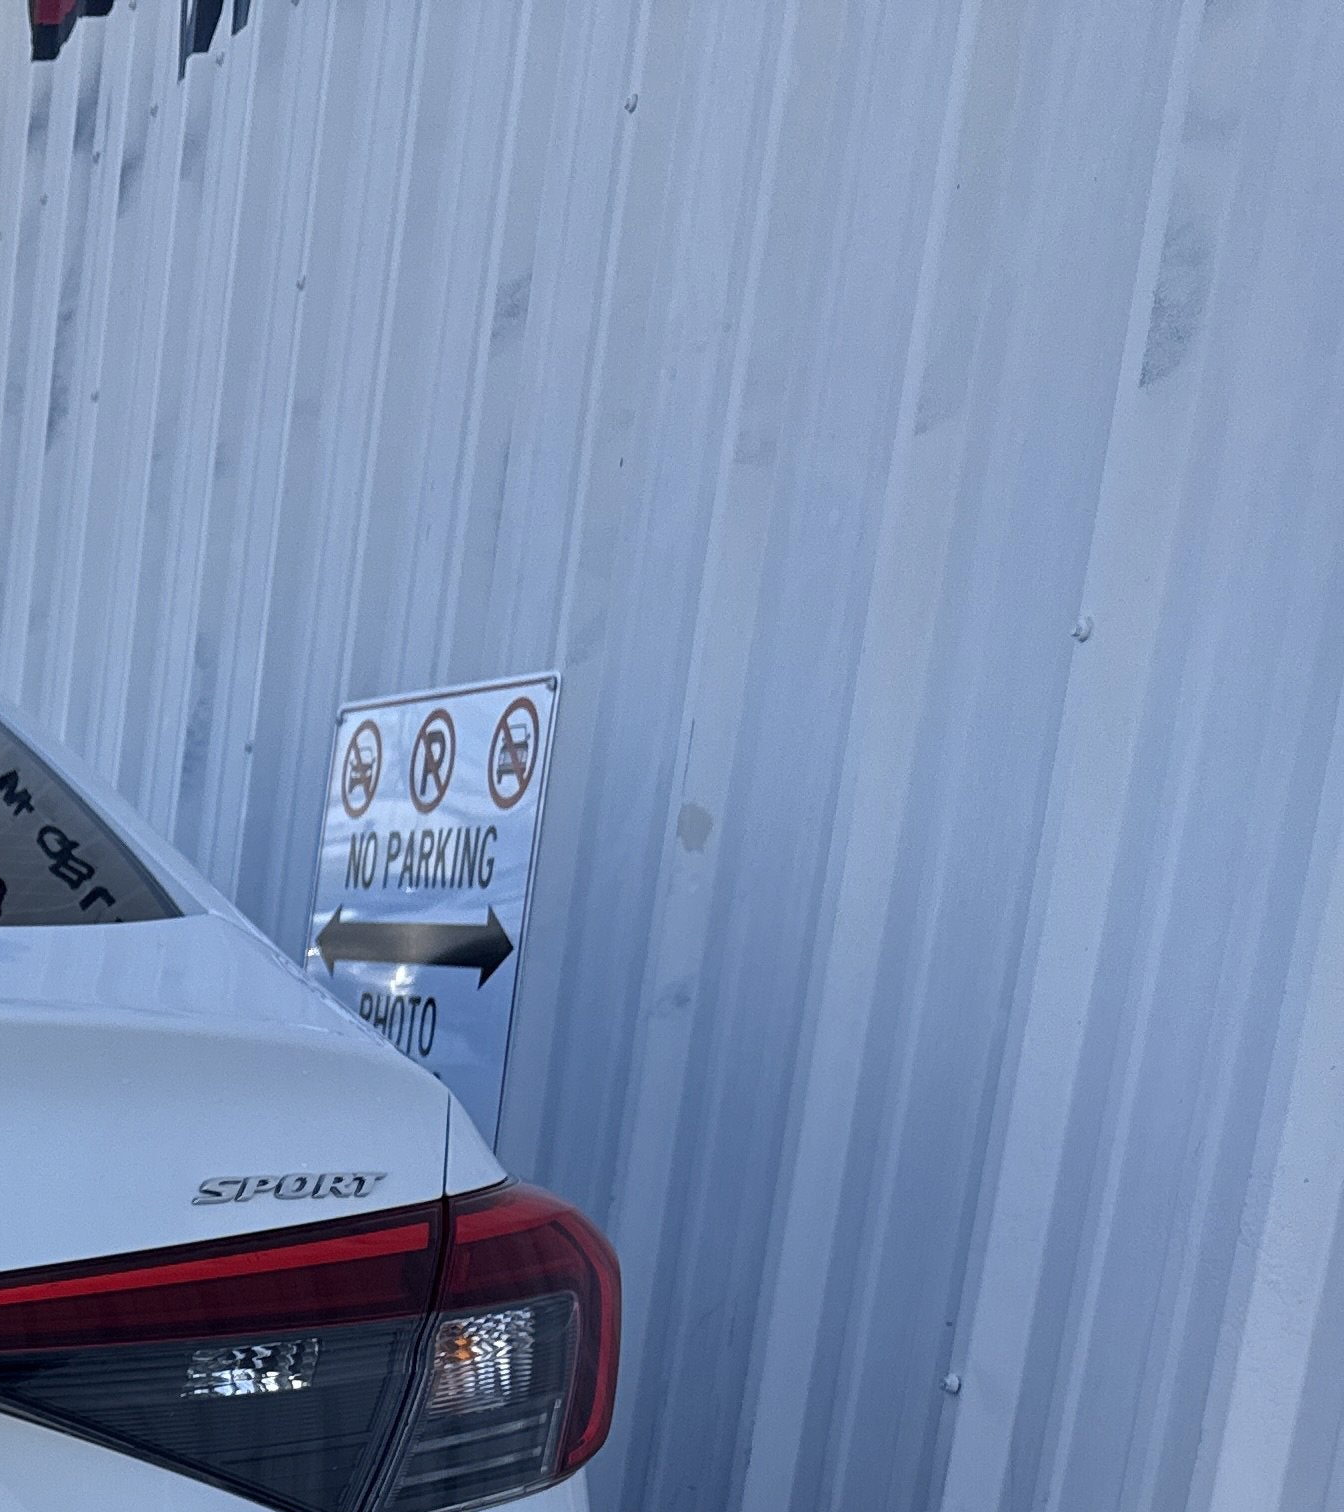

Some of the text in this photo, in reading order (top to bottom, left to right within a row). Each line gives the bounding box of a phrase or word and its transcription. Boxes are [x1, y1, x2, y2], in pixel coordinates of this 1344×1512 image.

[345, 824, 498, 890] NO PARKING
[191, 1172, 388, 1205] SPORT
